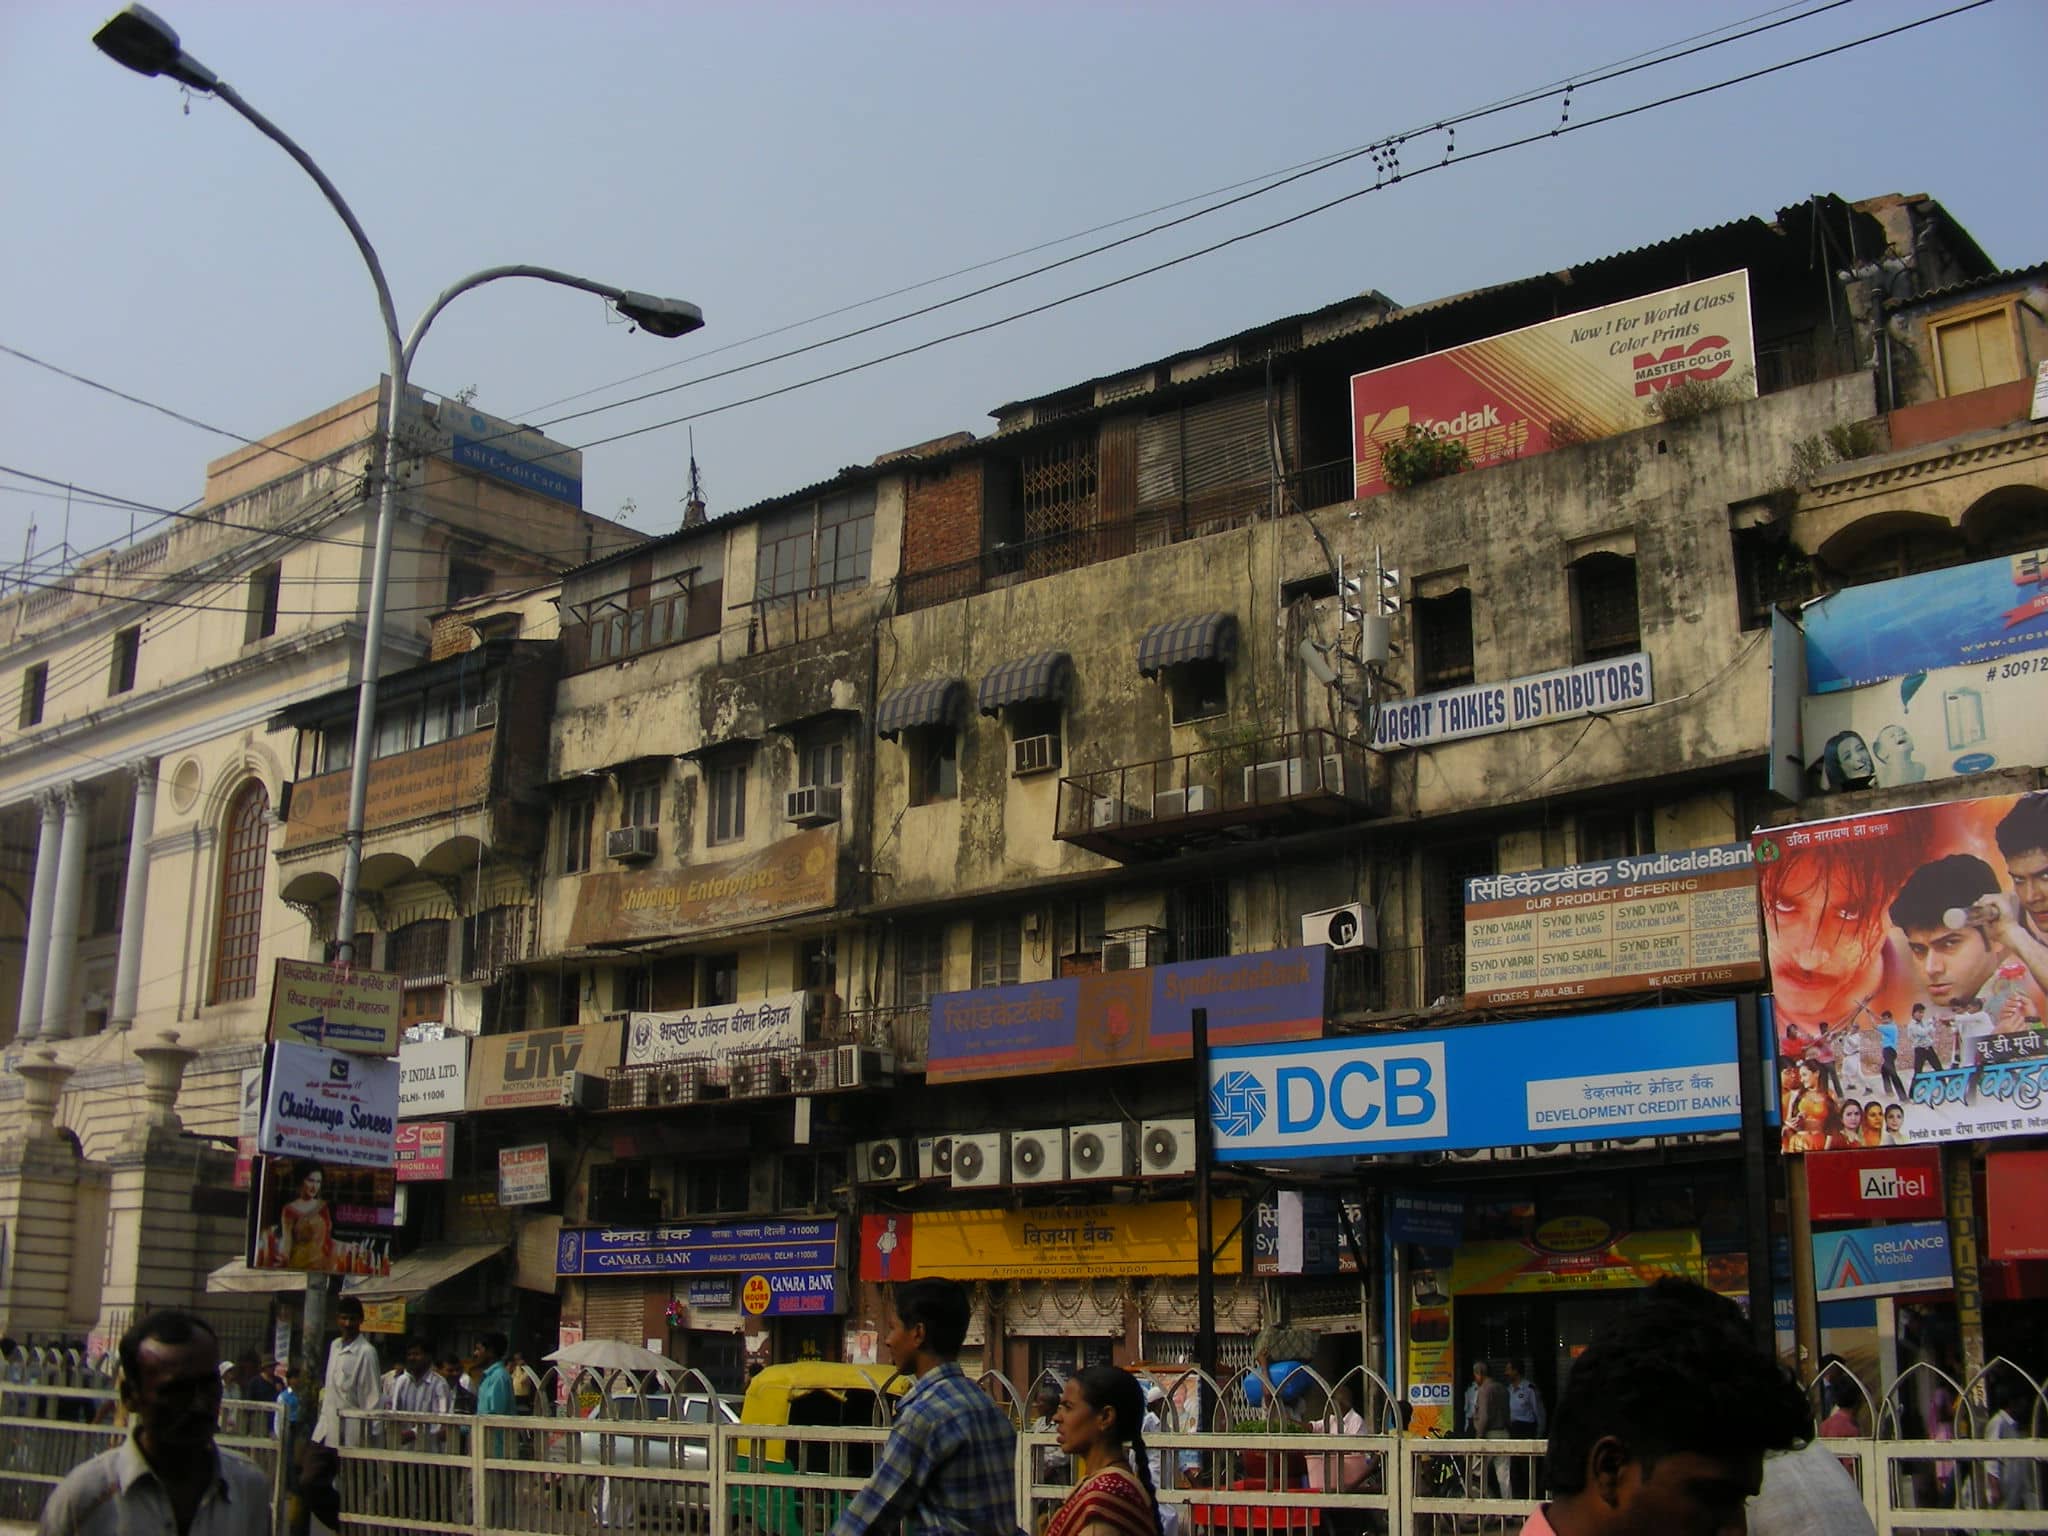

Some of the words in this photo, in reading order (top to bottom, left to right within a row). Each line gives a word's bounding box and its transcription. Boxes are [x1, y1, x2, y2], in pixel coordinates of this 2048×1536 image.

[1570, 326, 1604, 344] Now
[1614, 316, 1640, 333] For
[1643, 301, 1690, 327] World
[1693, 292, 1736, 313] Class
[1608, 335, 1649, 357] Color
[1651, 321, 1701, 345] Prints
[1635, 361, 1686, 382] MASTER
[1689, 349, 1732, 368] COLOR
[1415, 404, 1501, 442] Kodak
[1378, 702, 1433, 745] JAGAT
[1513, 661, 1644, 722] DISTRIBUTORS
[1785, 831, 1811, 848] उदित
[1813, 826, 1850, 842] नारायण
[1853, 824, 1867, 837] झा
[686, 867, 775, 902] Enterprises
[1526, 898, 1552, 911] OUR
[1555, 889, 1619, 908] PRODUCT
[1624, 880, 1699, 899] OFFERING
[1618, 904, 1647, 919] SYND
[1649, 900, 1680, 914] VIDYA
[1541, 914, 1571, 929] SYND
[1574, 910, 1606, 924] NIVAS
[1614, 917, 1661, 932] EDUCATION
[1472, 923, 1499, 937] SYND
[1549, 928, 1573, 941] HOME
[1618, 939, 1649, 953] SYND
[1653, 935, 1681, 950] RENT
[1470, 959, 1499, 973] SYND
[1500, 954, 1534, 970] VYAPAR
[1541, 951, 1570, 965] SYND
[1572, 947, 1607, 962] SARAL
[1648, 977, 1662, 987] WE
[1662, 973, 1697, 986] ACCEPT
[1701, 969, 1733, 982] TAXES
[1487, 990, 1530, 1004] LOCKERS
[1533, 985, 1585, 1000] AVAILABLE
[659, 1014, 698, 1045] भारतीय
[698, 1012, 729, 1039] जीवन
[758, 1003, 792, 1030] निगम
[503, 1031, 586, 1081] UTV
[408, 1066, 436, 1082] INDIA
[438, 1064, 460, 1080] LTD.
[1690, 1072, 1716, 1091] बैंक
[1275, 1056, 1437, 1135] DCB
[1912, 1066, 1977, 1111] कब
[279, 1091, 344, 1131] Chaitanya
[350, 1103, 392, 1134] Sarees
[1535, 1104, 1636, 1123] DEVELOPMENT
[1638, 1098, 1689, 1115] CREDIT
[1691, 1094, 1733, 1111] BANK
[1865, 1175, 1926, 1198] Airtel
[1023, 1222, 1079, 1246] विजया
[1082, 1219, 1116, 1244] बैंक
[599, 1251, 652, 1267] CANARA
[655, 1248, 693, 1264] BANK
[1875, 1252, 1914, 1267] Mobile
[1038, 1266, 1058, 1278] you
[1061, 1265, 1082, 1274] can
[1087, 1263, 1114, 1274] bank
[1119, 1263, 1149, 1276] upon
[749, 1280, 763, 1292] 24
[770, 1276, 806, 1293] CANARA
[808, 1274, 835, 1292] BANK
[744, 1293, 769, 1302] HOURS
[749, 1302, 765, 1310] ATM
[1421, 1385, 1450, 1399] DCB
